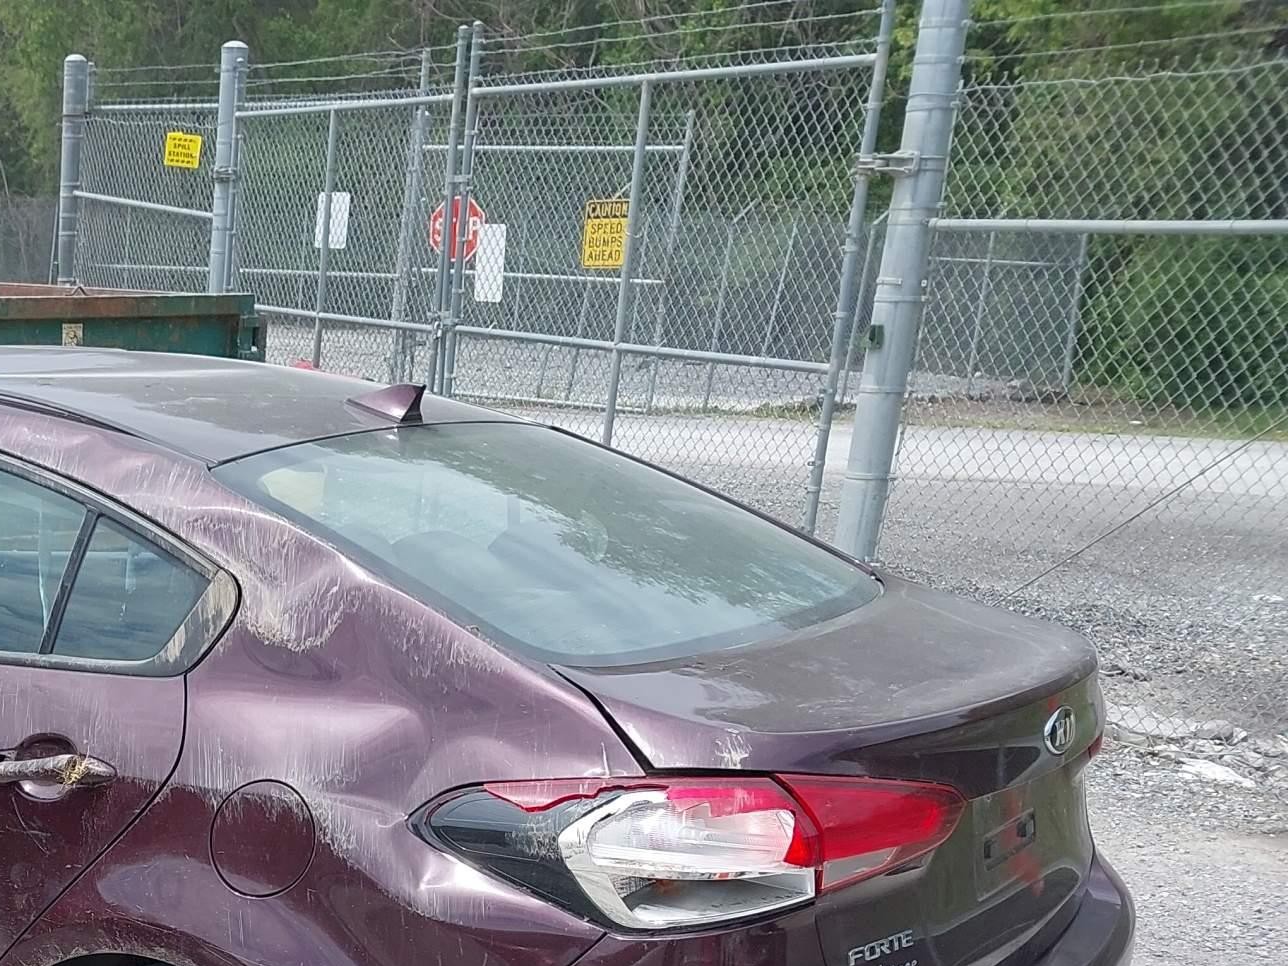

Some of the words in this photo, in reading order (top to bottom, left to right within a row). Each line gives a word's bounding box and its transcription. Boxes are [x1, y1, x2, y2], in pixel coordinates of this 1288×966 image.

[172, 143, 191, 151] SPILL
[168, 151, 194, 159] STATION
[588, 202, 629, 218] CAUTION
[591, 222, 623, 235] SPEED
[588, 236, 623, 249] BUMPS
[586, 250, 621, 262] AHEAD
[847, 929, 915, 966] FORTE
